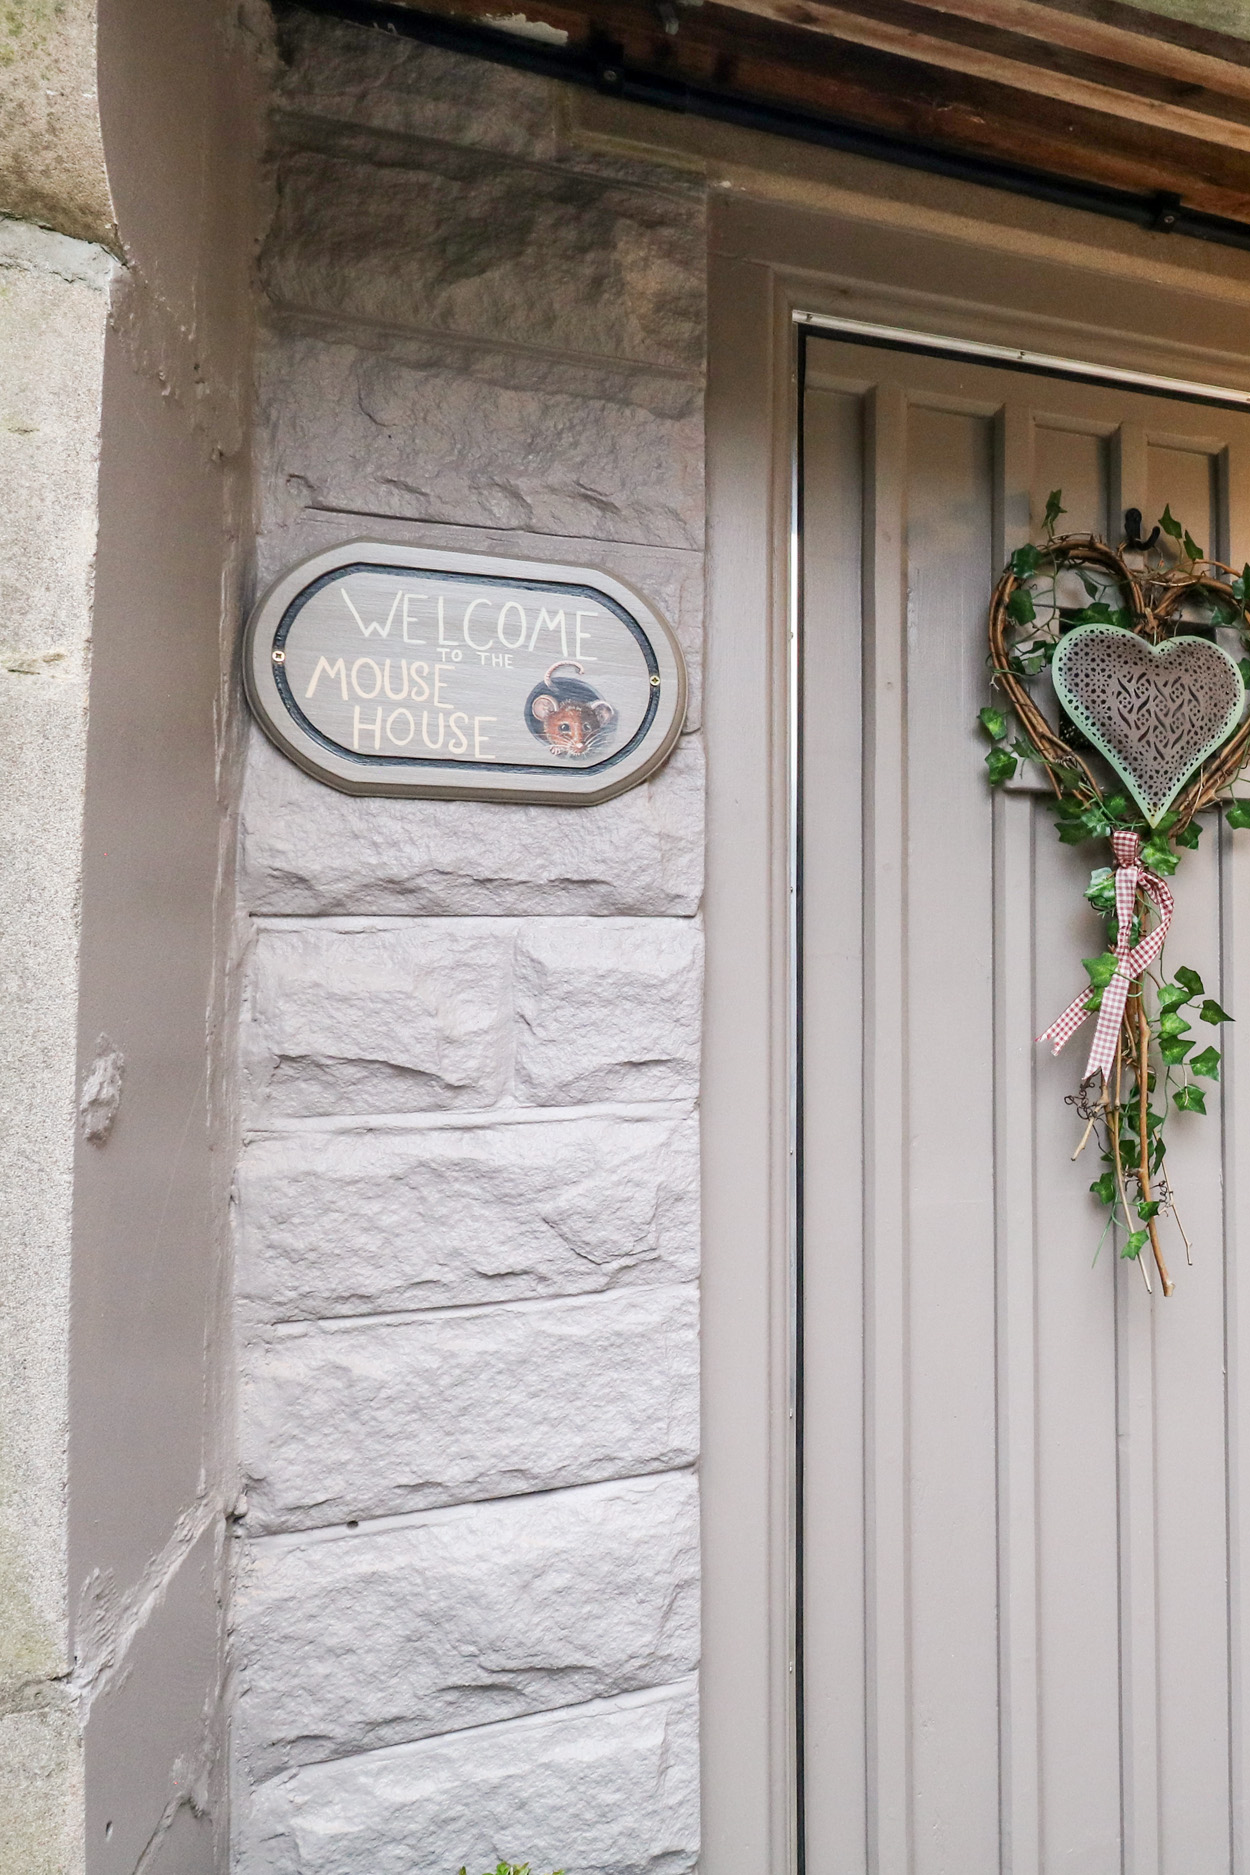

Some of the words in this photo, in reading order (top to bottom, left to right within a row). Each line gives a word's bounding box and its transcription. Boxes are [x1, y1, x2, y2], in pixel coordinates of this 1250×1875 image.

[341, 588, 599, 661] WELCOME
[305, 656, 456, 709] MOUSE
[437, 647, 463, 664] TO
[477, 652, 514, 669] THE
[353, 705, 498, 759] HOUSE
